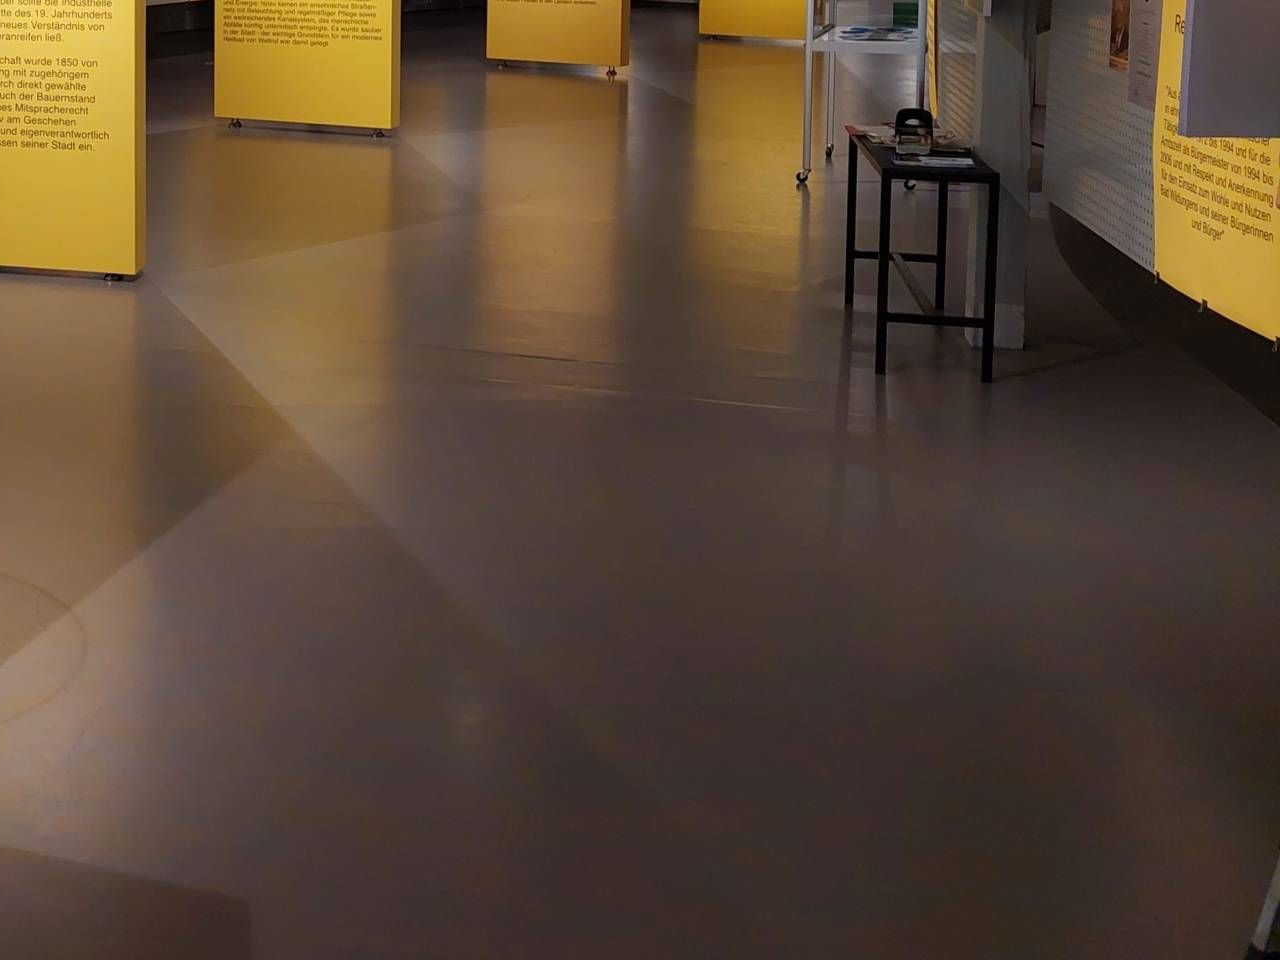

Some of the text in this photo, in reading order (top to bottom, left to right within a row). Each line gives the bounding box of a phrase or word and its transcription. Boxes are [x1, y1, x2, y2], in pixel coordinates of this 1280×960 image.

[23, 57, 53, 66] wurde
[55, 57, 79, 67] 1850
[80, 60, 98, 68] von
[12, 67, 27, 77] mit
[16, 79, 43, 89] direkt
[44, 81, 87, 92] gewählte
[18, 91, 34, 102] der
[36, 92, 96, 103] Bauernstand
[14, 103, 89, 115] Mitspracherecht
[6, 116, 21, 124] am
[23, 115, 77, 126] Geschehen
[0, 127, 18, 136] und
[19, 128, 110, 140] eigenverantwortlich
[20, 139, 50, 149] seiner
[50, 139, 76, 150] Stadt
[77, 141, 95, 151] ein.
[1236, 147, 1246, 158] und
[1249, 149, 1257, 161] für
[1260, 152, 1271, 165] die
[1244, 165, 1260, 181] 1994
[1263, 172, 1274, 185] bis
[1228, 178, 1274, 208] Anerkennung
[1245, 204, 1272, 222] Nutzen
[1231, 215, 1274, 243] Bürgerinnen
